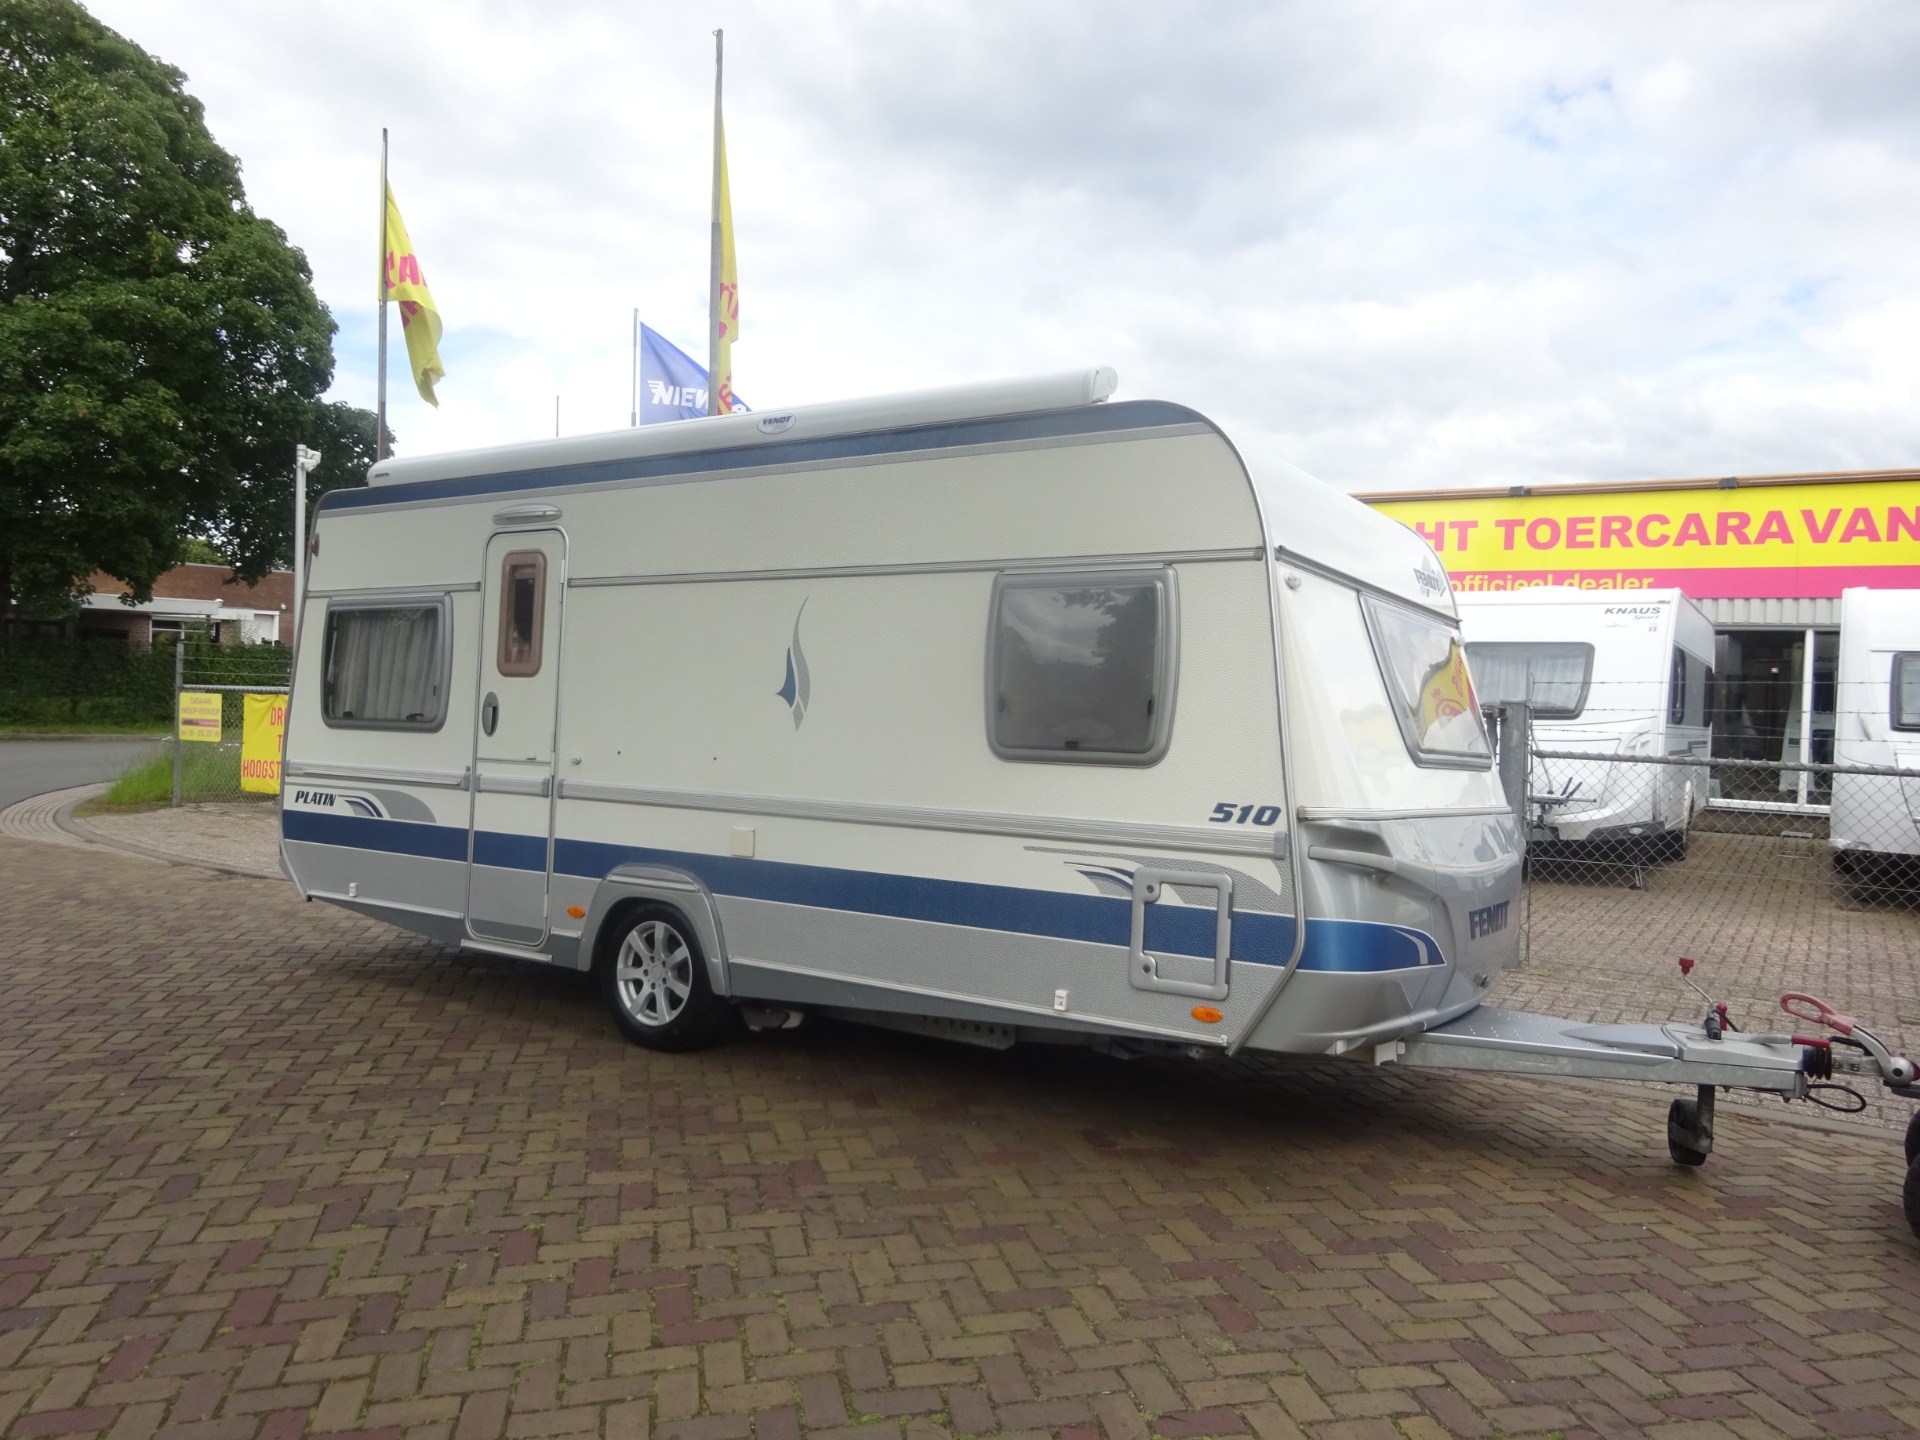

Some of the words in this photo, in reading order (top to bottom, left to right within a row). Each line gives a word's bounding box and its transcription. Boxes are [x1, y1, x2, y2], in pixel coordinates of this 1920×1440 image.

[763, 415, 792, 425] FENDT
[1563, 572, 1654, 591] dealer
[1604, 607, 1661, 615] KNAUS
[295, 790, 336, 807] PLATIN
[1209, 802, 1281, 826] 510
[1469, 900, 1510, 940] FENDT
